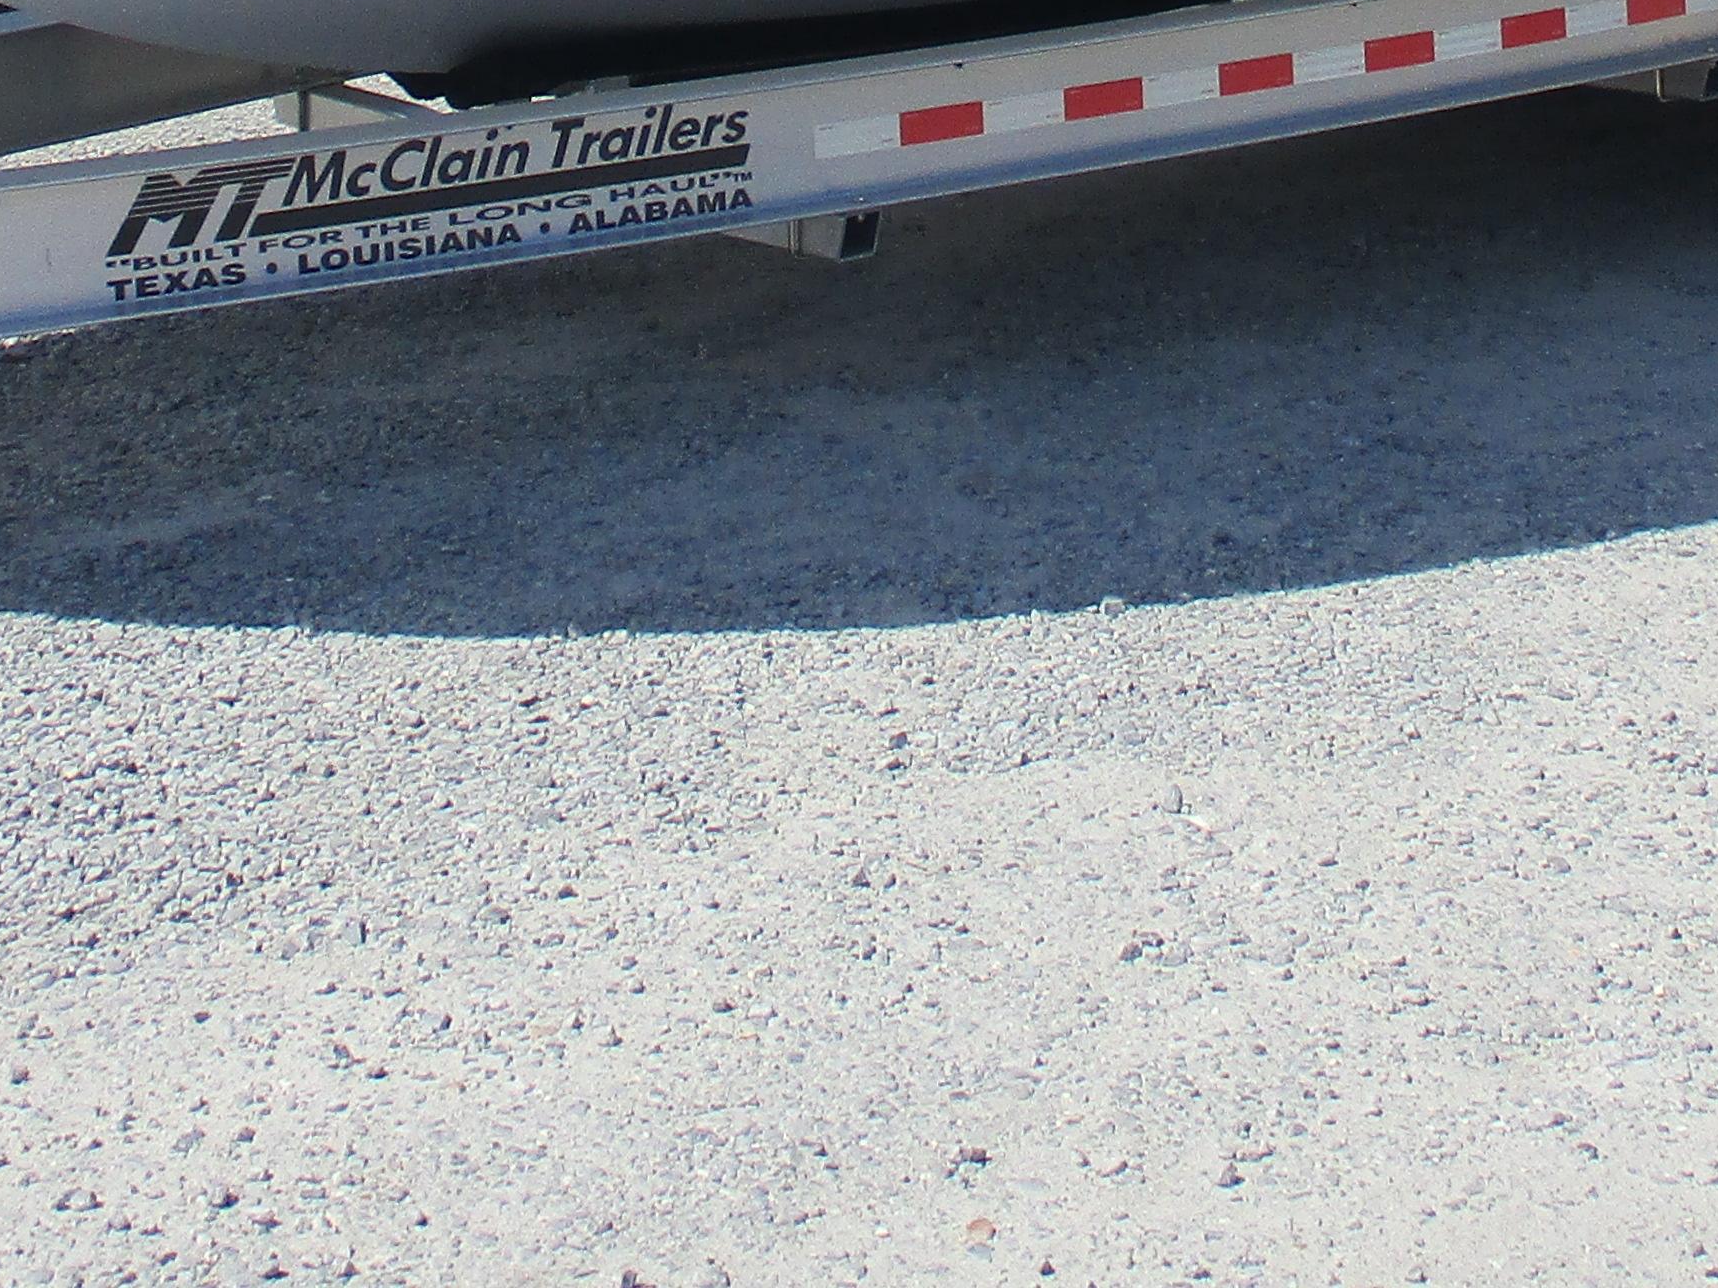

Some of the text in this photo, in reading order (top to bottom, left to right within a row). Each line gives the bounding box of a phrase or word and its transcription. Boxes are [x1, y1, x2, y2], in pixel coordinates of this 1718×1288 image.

[281, 103, 749, 208] McClain Trailers
[106, 187, 754, 301] TEXAS LOUISIANA ALABAMA
[258, 230, 343, 253] FOR
[354, 216, 431, 239] THE
[449, 194, 592, 226] LONG
